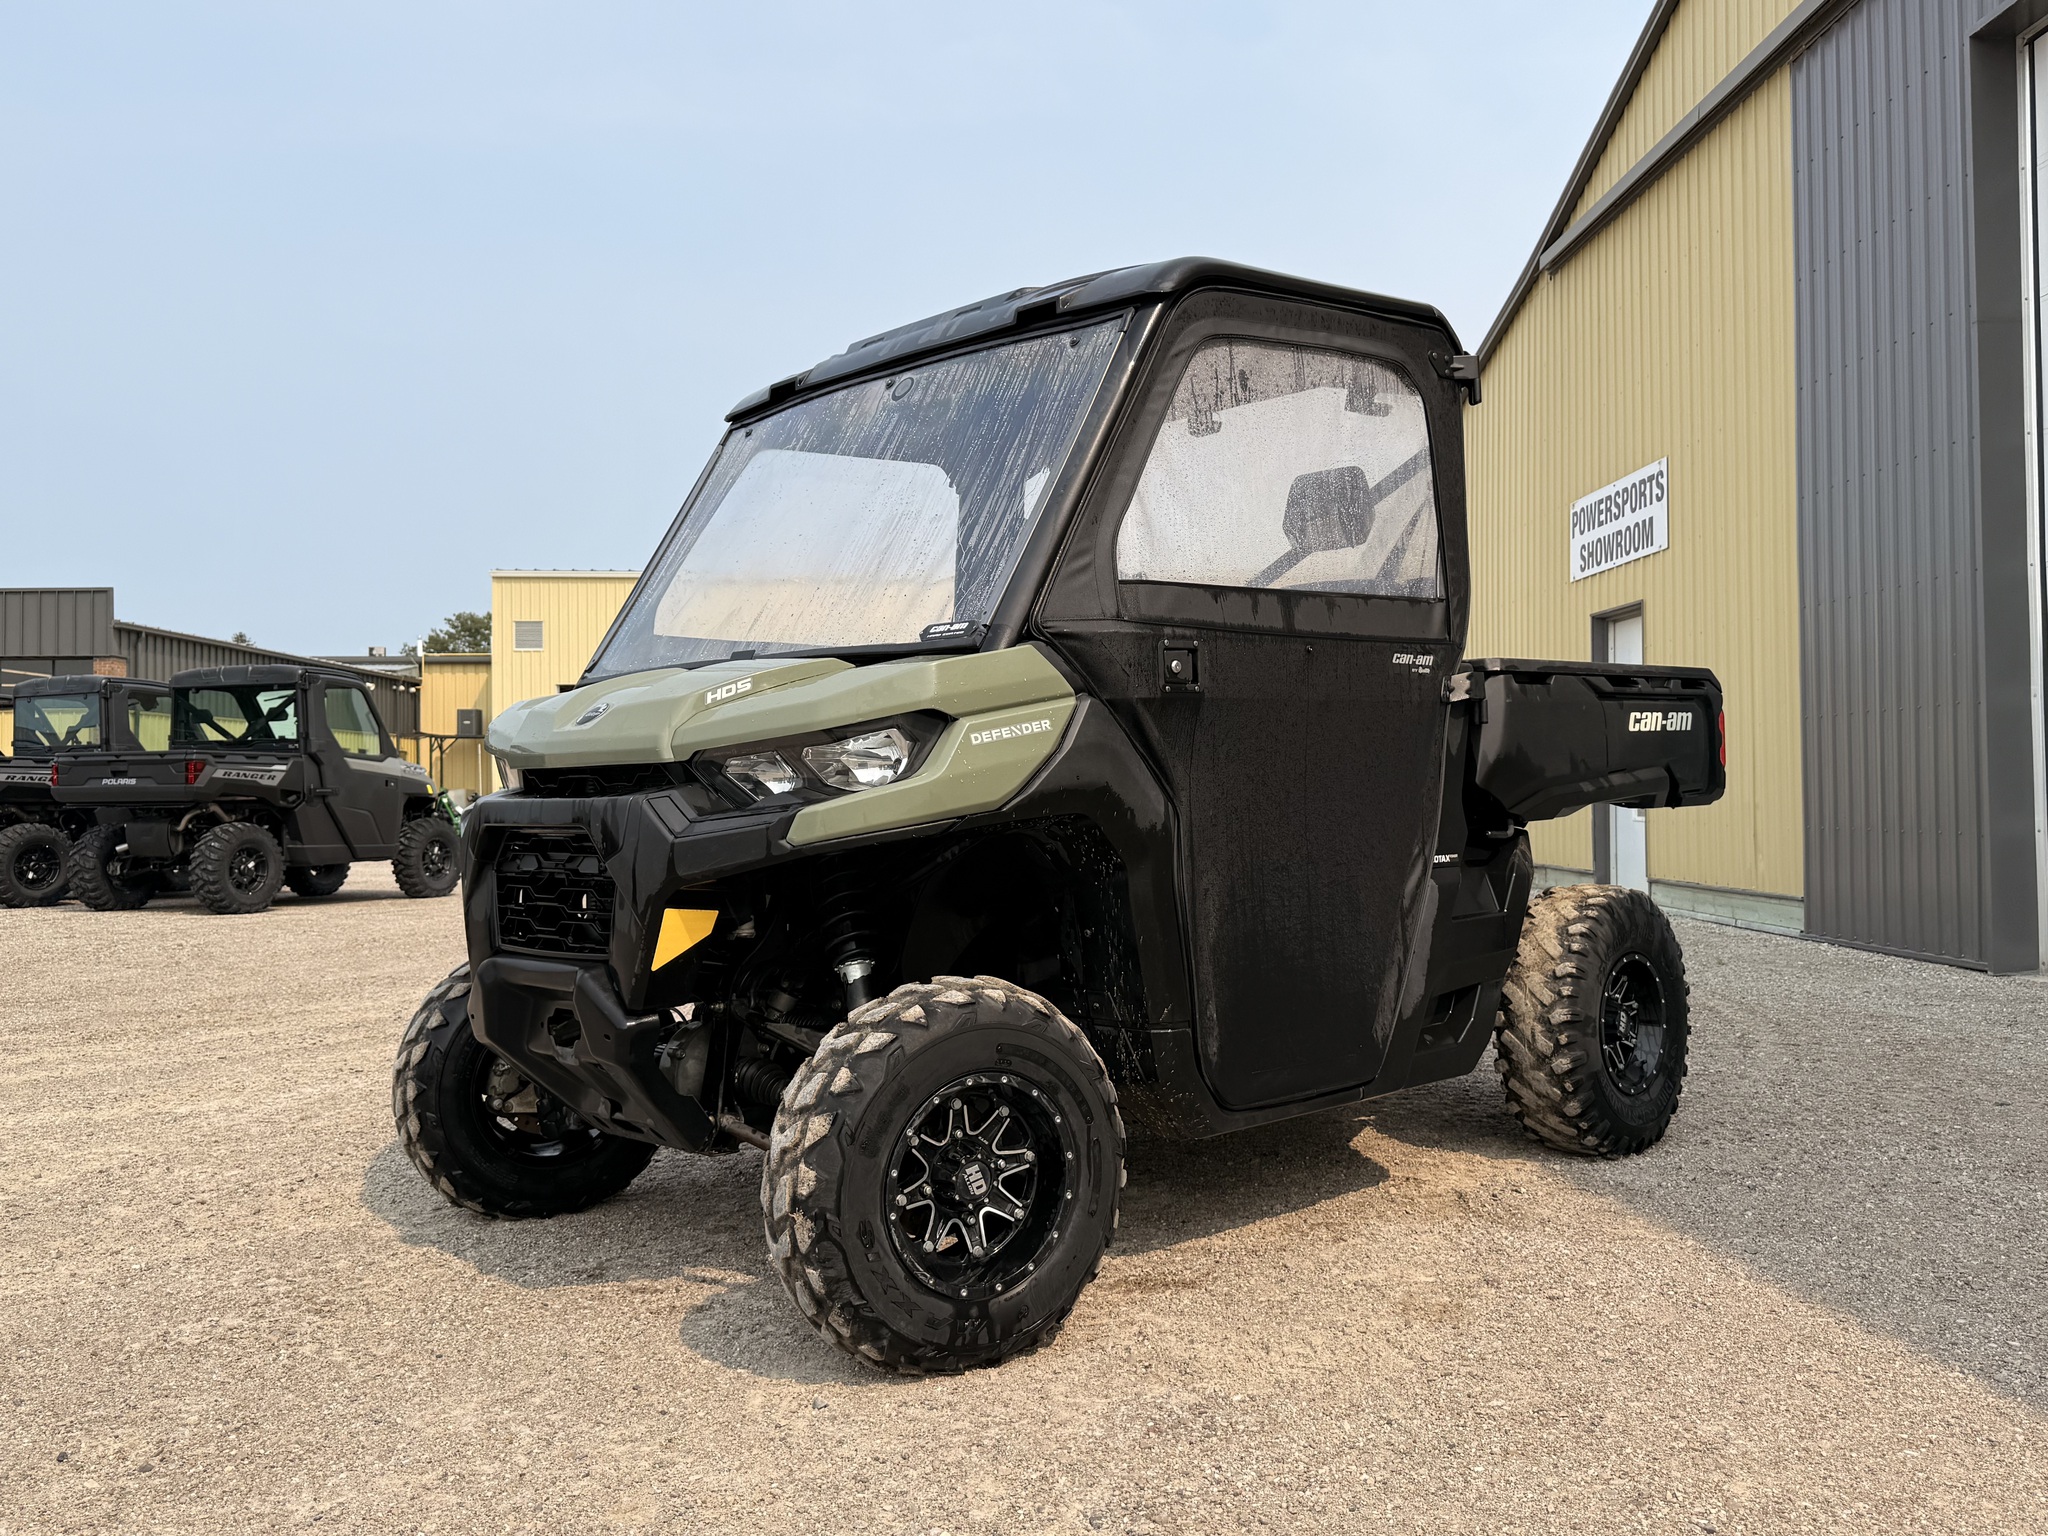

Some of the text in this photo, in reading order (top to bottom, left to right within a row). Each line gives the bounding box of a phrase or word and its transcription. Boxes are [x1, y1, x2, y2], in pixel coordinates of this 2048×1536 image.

[1571, 469, 1665, 540] POWERSPORTS
[1580, 515, 1654, 573] SHOWROOM
[1392, 653, 1434, 666] can-am
[1628, 711, 1693, 732] can-am
[969, 719, 1052, 746] DEFENDER
[5, 774, 52, 782] RANG
[101, 777, 137, 786] POLARIS
[222, 770, 277, 781] RANGER
[1433, 853, 1451, 864] OTAX
[965, 1164, 987, 1196] HD
